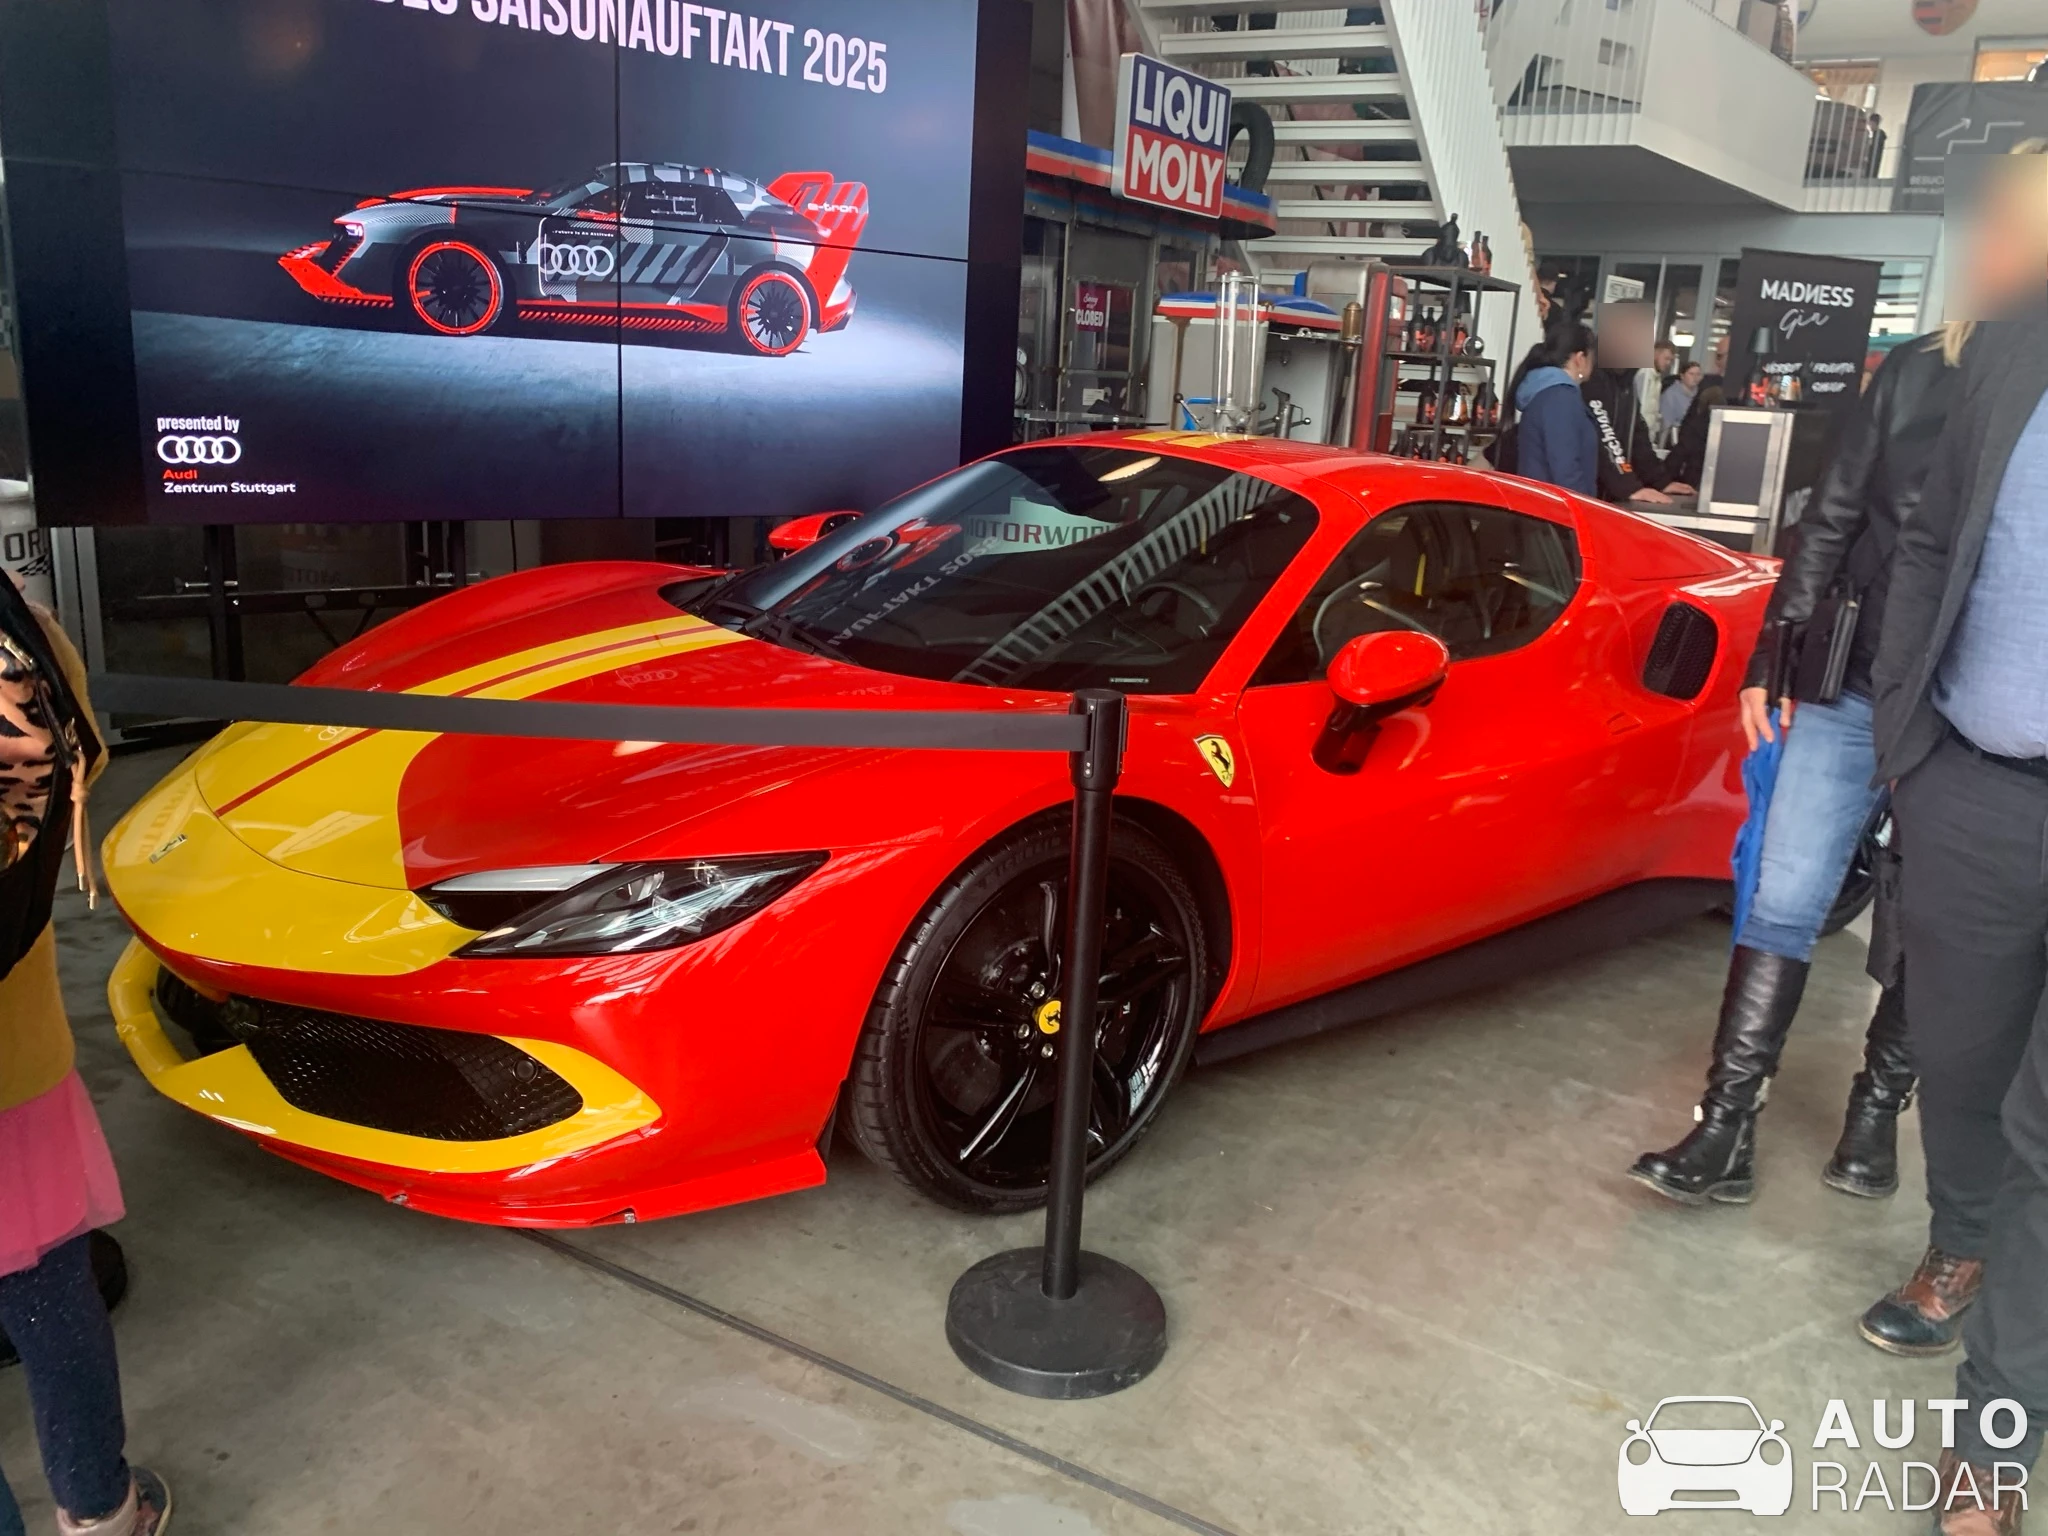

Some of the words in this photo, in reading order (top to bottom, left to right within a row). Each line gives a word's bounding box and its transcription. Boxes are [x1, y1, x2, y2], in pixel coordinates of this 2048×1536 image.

[803, 28, 887, 94] 2025
[1135, 63, 1227, 146] LIQUI
[1130, 133, 1223, 208] MOLY
[807, 202, 858, 213] e-tron
[1075, 309, 1104, 327] CLOSED
[1779, 308, 1830, 340] Gin
[157, 416, 222, 432] presented
[224, 416, 240, 433] by
[163, 469, 198, 480] Audi
[164, 482, 228, 493] Zentrum
[231, 482, 296, 495] Stuttgart
